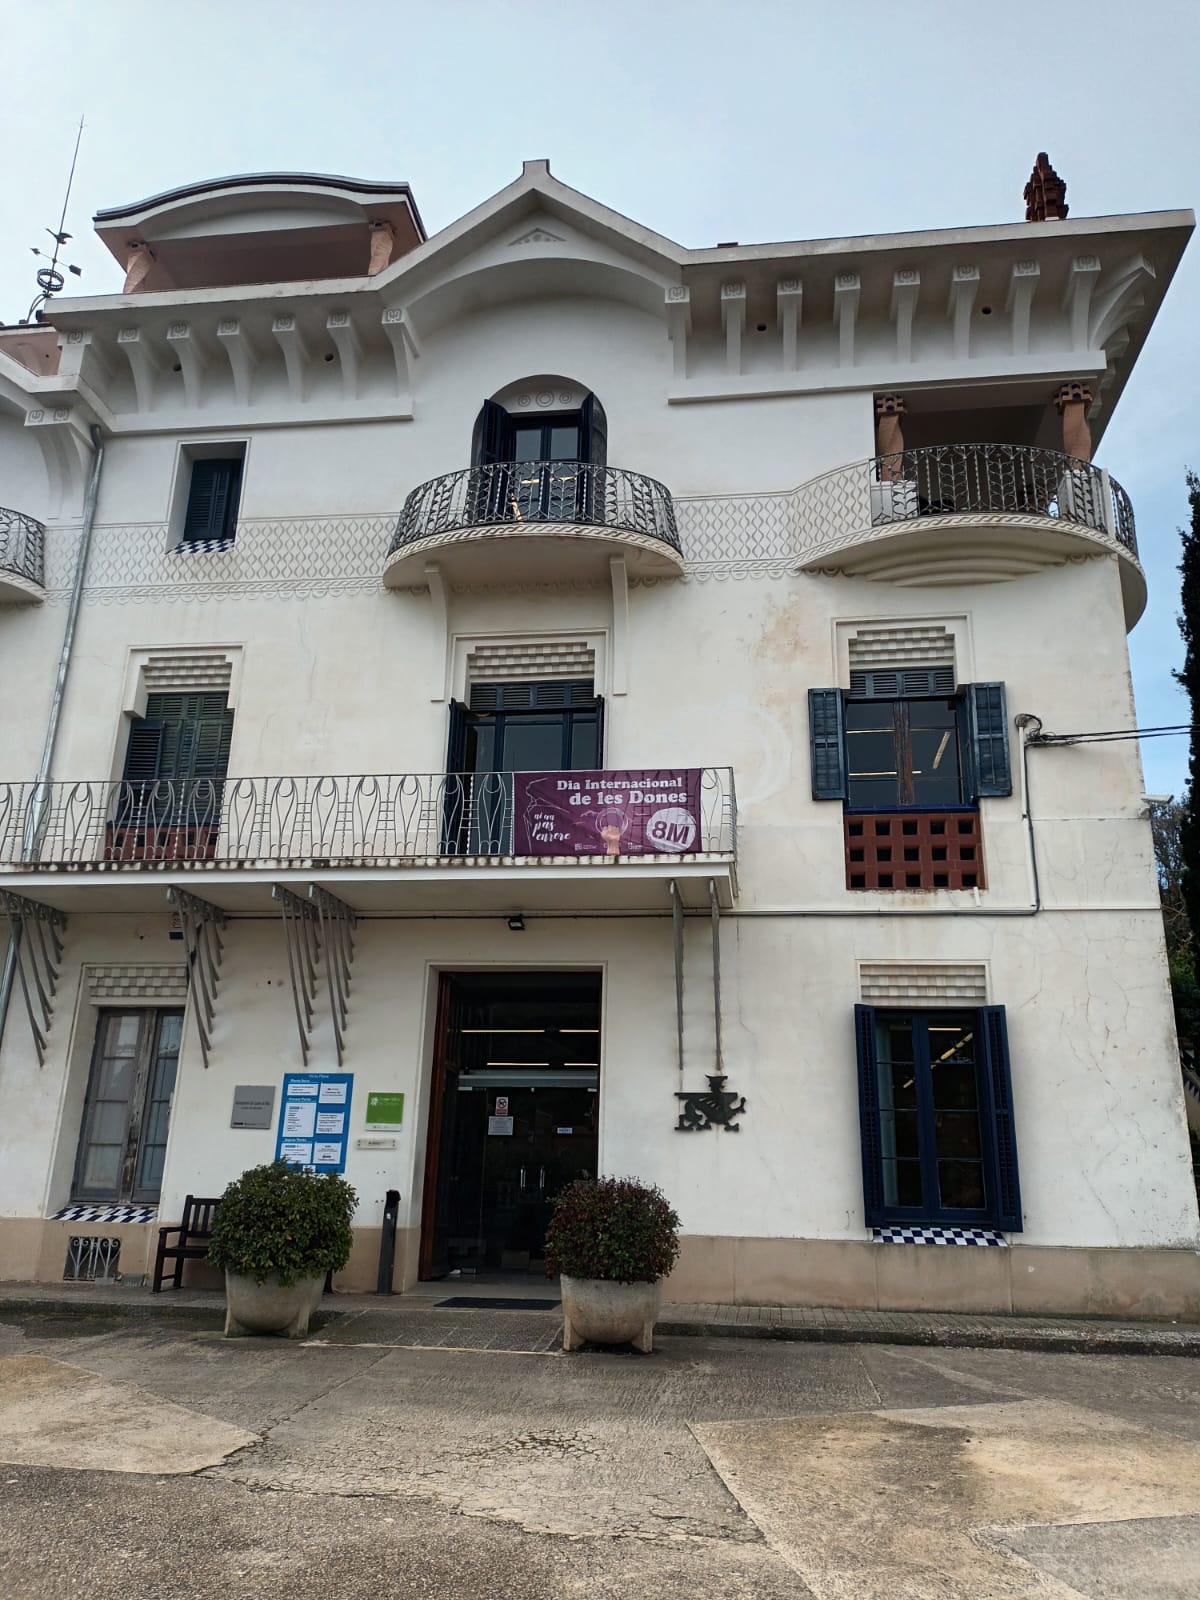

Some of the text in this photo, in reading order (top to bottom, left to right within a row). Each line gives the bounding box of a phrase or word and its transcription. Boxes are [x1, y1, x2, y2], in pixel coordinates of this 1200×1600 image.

[557, 777, 682, 790] Dia Internacional
[569, 790, 687, 805] de les Dones
[532, 821, 555, 837] pas
[652, 820, 690, 844] 8M
